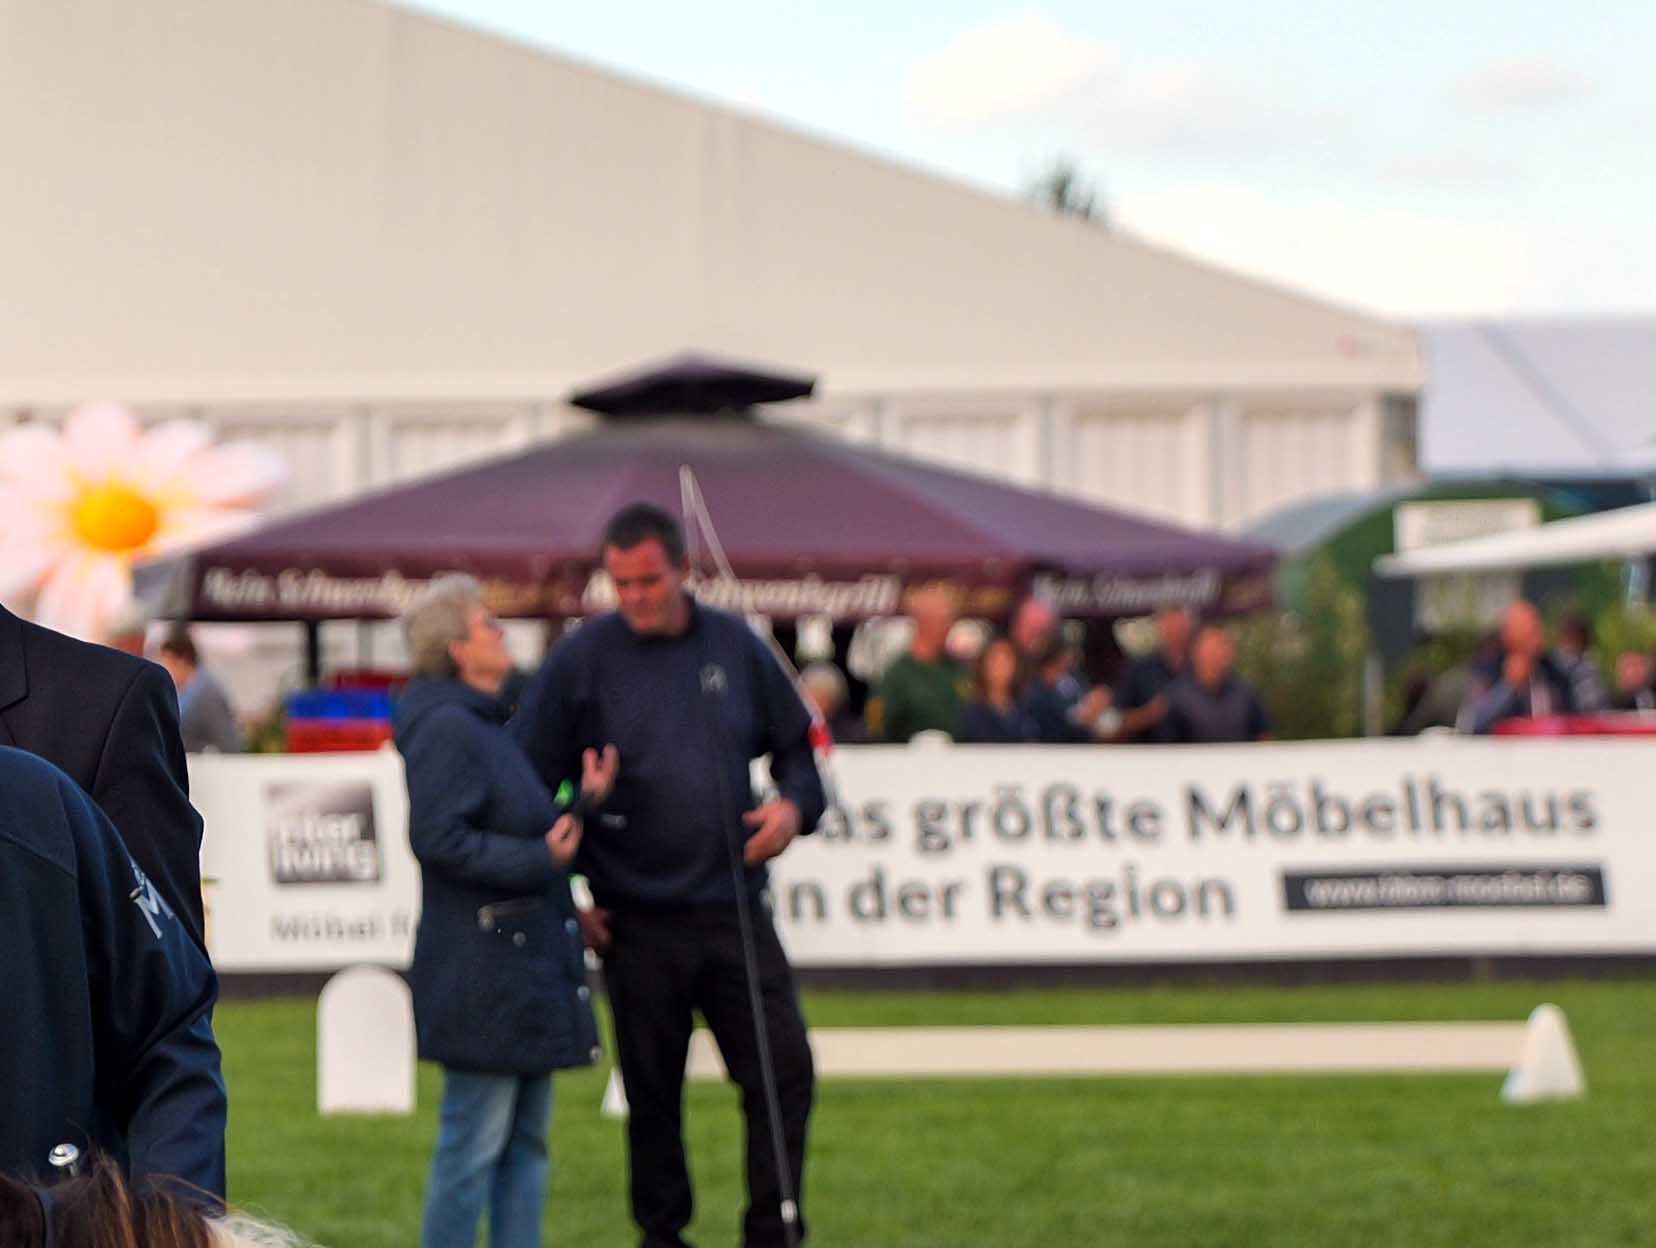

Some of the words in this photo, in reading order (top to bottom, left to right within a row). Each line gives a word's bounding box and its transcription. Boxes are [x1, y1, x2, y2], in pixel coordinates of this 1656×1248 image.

[818, 796, 892, 844] as
[914, 784, 1162, 856] größte
[1184, 778, 1598, 840] Möbelhaus
[848, 866, 964, 922] der
[988, 864, 1236, 932] Region
